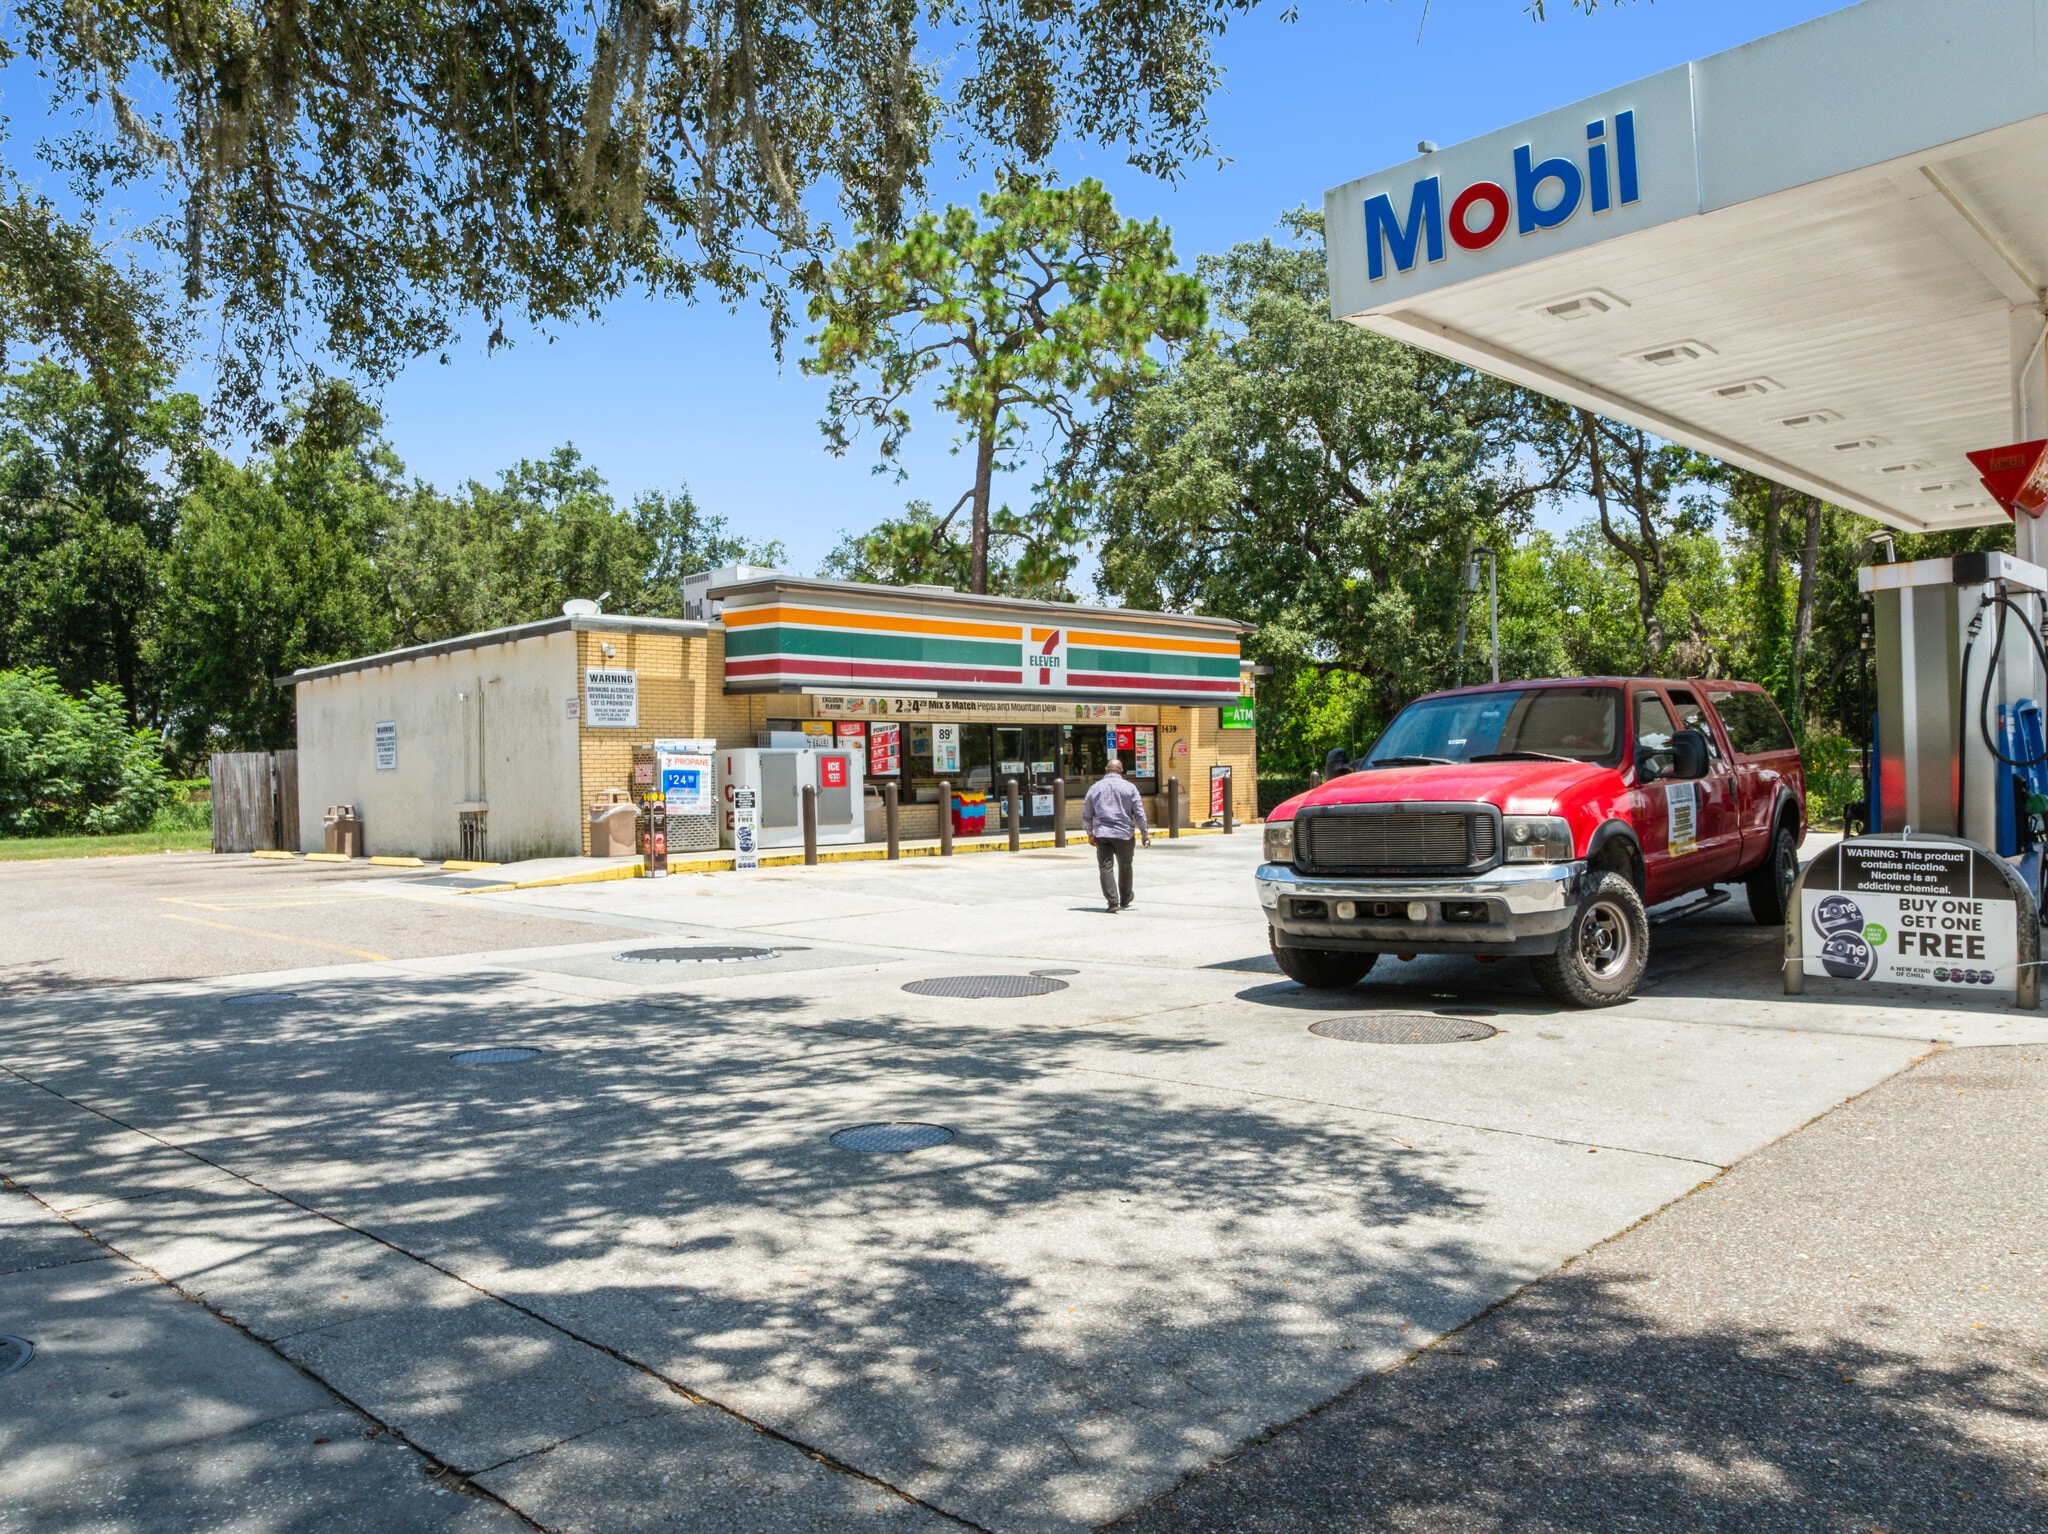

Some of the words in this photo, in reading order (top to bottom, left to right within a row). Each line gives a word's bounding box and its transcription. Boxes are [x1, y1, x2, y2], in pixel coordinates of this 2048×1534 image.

[1364, 109, 1640, 283] Mobil
[589, 674, 633, 683] WARNING
[896, 700, 904, 713] 2
[929, 701, 943, 710] Mix
[945, 701, 951, 710] &
[952, 702, 977, 711] Match
[978, 702, 996, 712] Pepsi
[997, 703, 1010, 711] and
[1011, 703, 1041, 711] Mountain
[1042, 704, 1057, 712] Dew
[1233, 709, 1254, 721] ATM
[873, 725, 889, 734] POWER
[1161, 725, 1177, 734] 1439
[675, 758, 710, 766] PROPANE
[828, 762, 840, 772] ICE
[1847, 848, 1899, 859] WARNING:
[1901, 850, 1922, 860] This
[1924, 852, 1964, 862] product
[1861, 860, 1903, 870] contains
[1905, 862, 1948, 873] nicotine.
[1871, 871, 1911, 881] Nicotine
[1913, 873, 1922, 881] is
[1924, 874, 1937, 883] an
[1857, 881, 1901, 891] addictive
[1904, 883, 1951, 895] chemical.
[1899, 898, 1938, 913] BUY
[1942, 901, 1983, 915] ONE
[1901, 914, 1937, 929] GET
[1941, 917, 1982, 931] ONE
[1898, 930, 1986, 960] FREE
